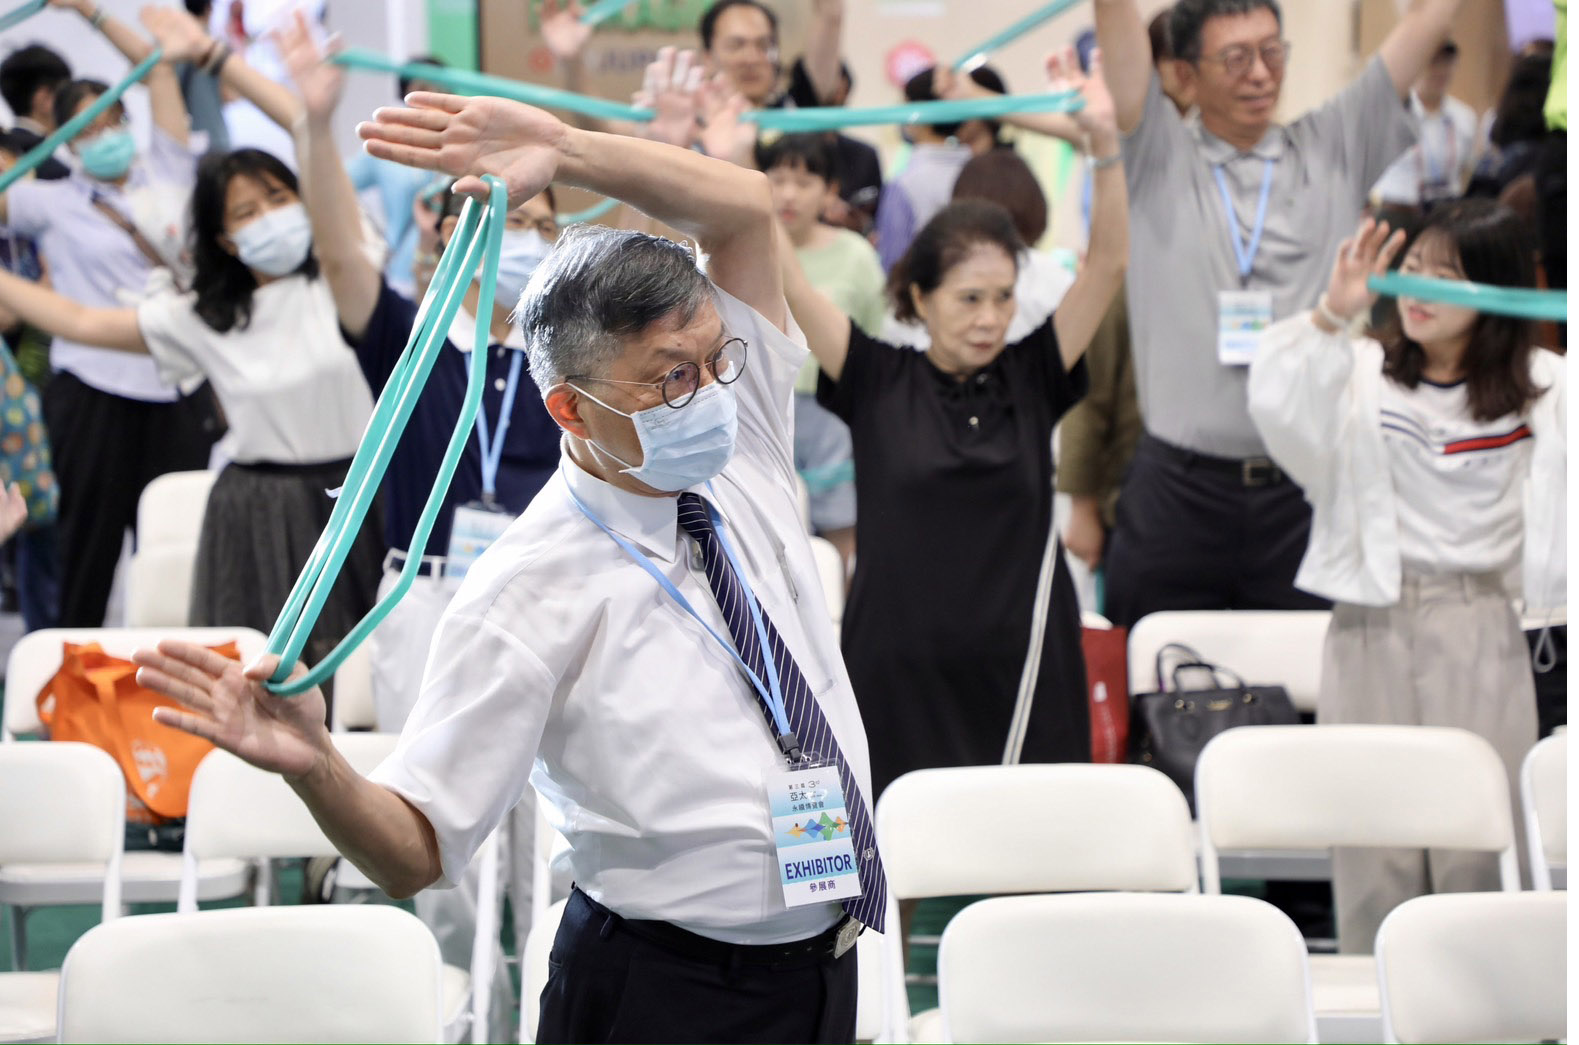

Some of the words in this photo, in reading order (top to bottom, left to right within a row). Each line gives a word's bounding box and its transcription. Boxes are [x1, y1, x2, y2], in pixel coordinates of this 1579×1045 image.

[790, 791, 807, 801] 亞太
[785, 854, 852, 880] EXHIBITOR
[809, 880, 836, 892] 參展商
